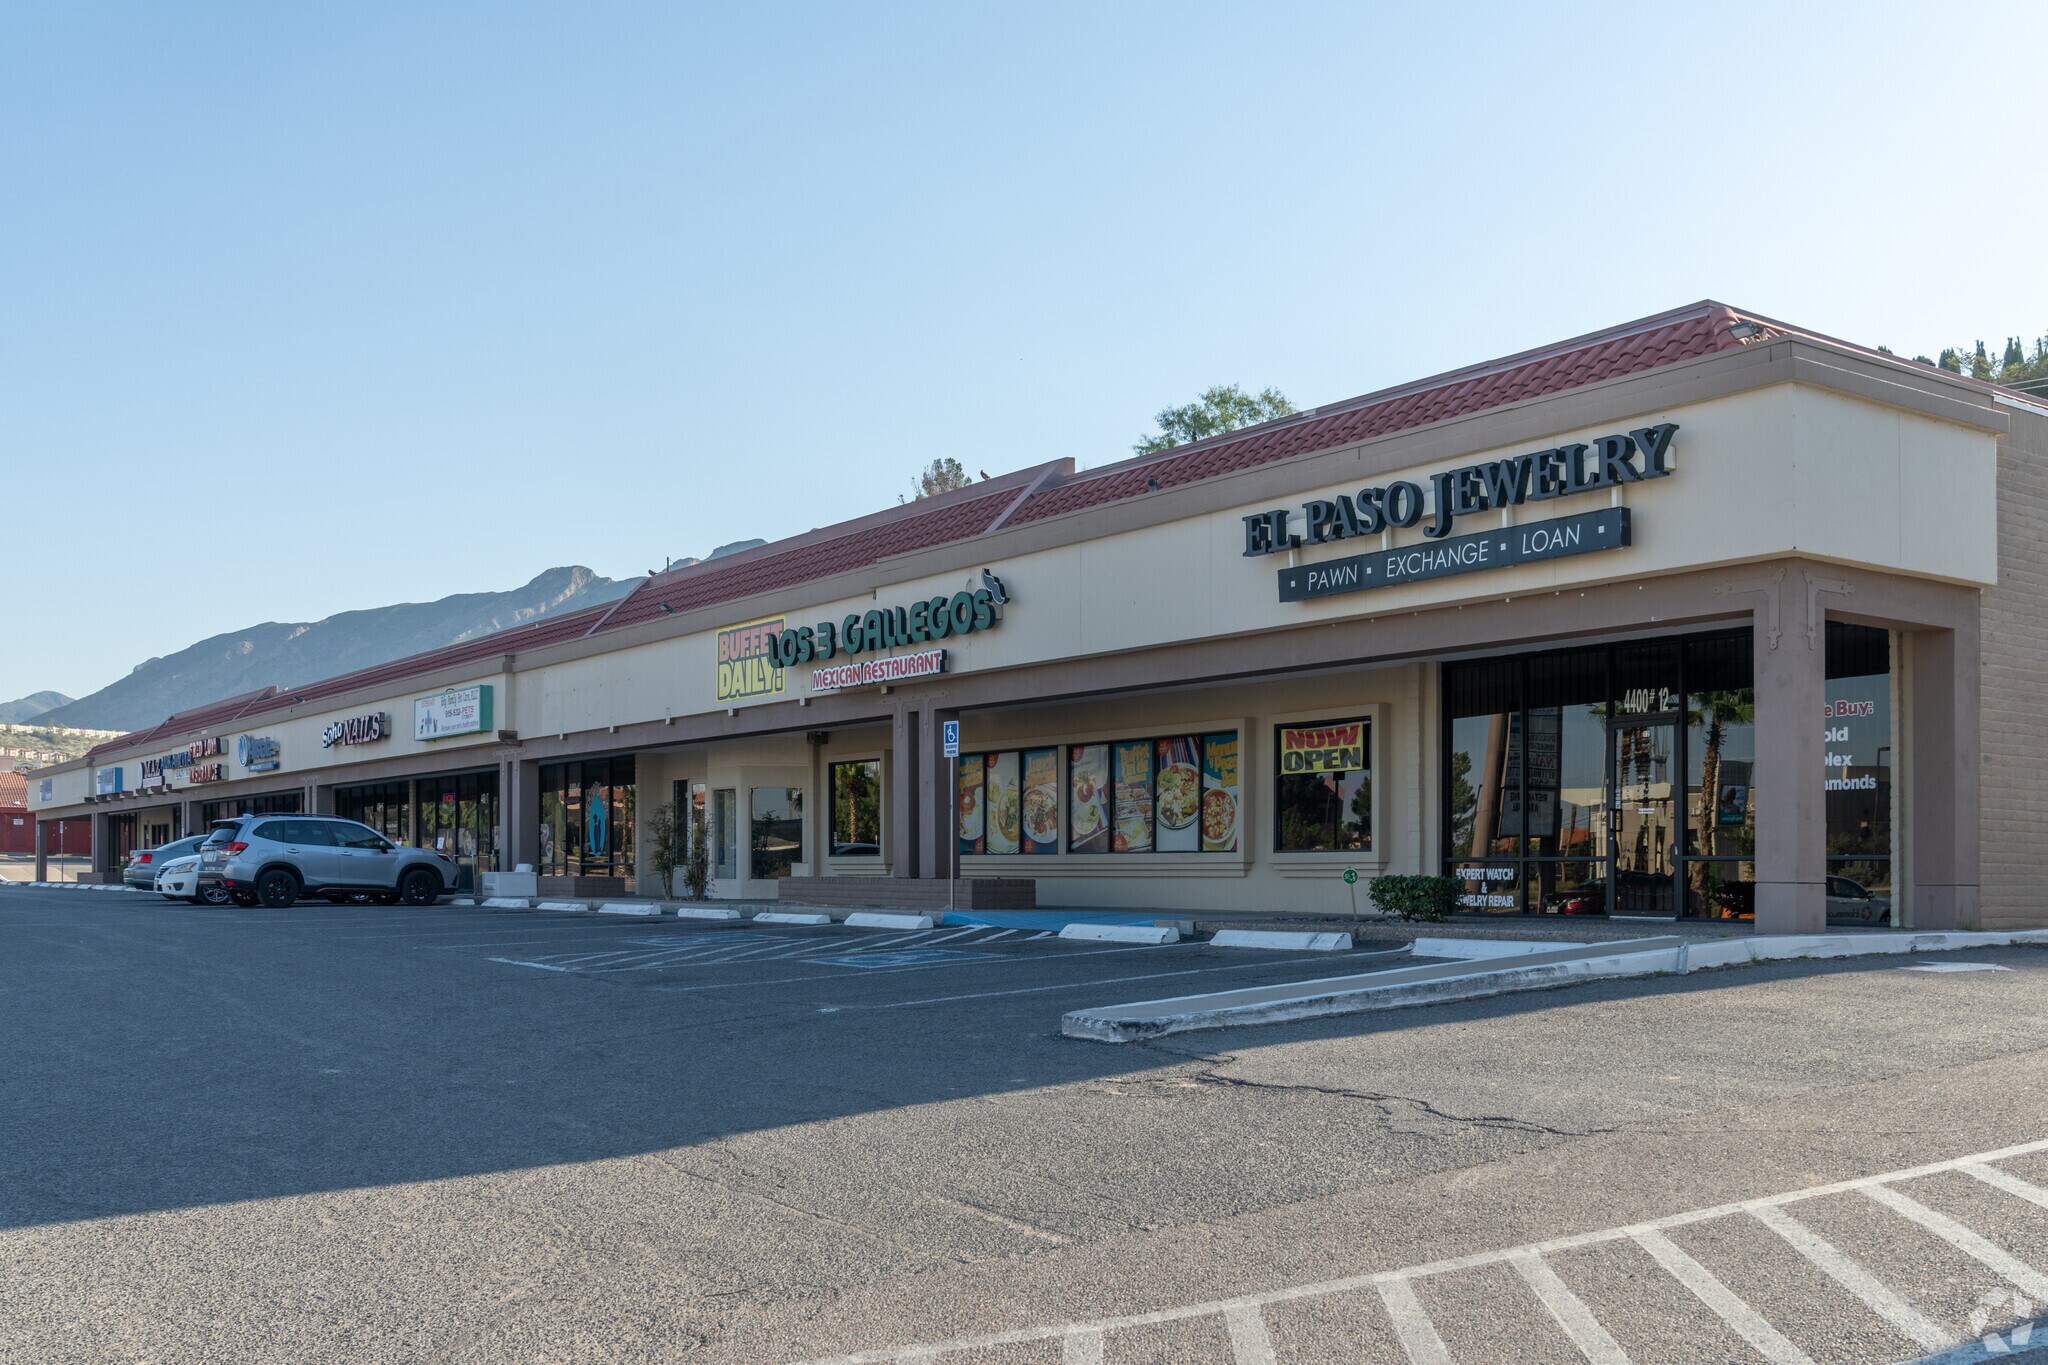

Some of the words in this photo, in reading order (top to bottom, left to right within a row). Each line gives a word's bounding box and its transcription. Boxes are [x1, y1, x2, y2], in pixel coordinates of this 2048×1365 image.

[1242, 509, 1299, 557] EL
[1302, 480, 1424, 545] PASO
[1423, 423, 1679, 538] JEWELRY
[1308, 564, 1357, 591] PAWN
[1386, 541, 1489, 578] EXCHANGE
[1522, 524, 1580, 555] LOAN
[768, 626, 815, 669] LOS
[817, 621, 837, 661] 3
[841, 588, 996, 655] GALLEGOS
[812, 663, 862, 690] MEXICAN
[863, 652, 943, 682] RESTAURANT
[1624, 688, 1648, 713] 4400
[1659, 687, 1669, 712] 12
[1835, 700, 1874, 717] Buy:
[322, 721, 344, 748] Soho
[343, 711, 385, 746] NAILS
[1285, 725, 1359, 750] NOW
[1825, 727, 1849, 742] old
[1284, 747, 1360, 771] OPEN
[1825, 752, 1853, 767] lex
[1825, 774, 1877, 791] monds
[1456, 868, 1485, 880] EXPERT
[1486, 868, 1514, 880] WATCH
[1481, 881, 1488, 894] &
[1457, 895, 1488, 907] WELRY
[1489, 895, 1514, 907] REPAIR
